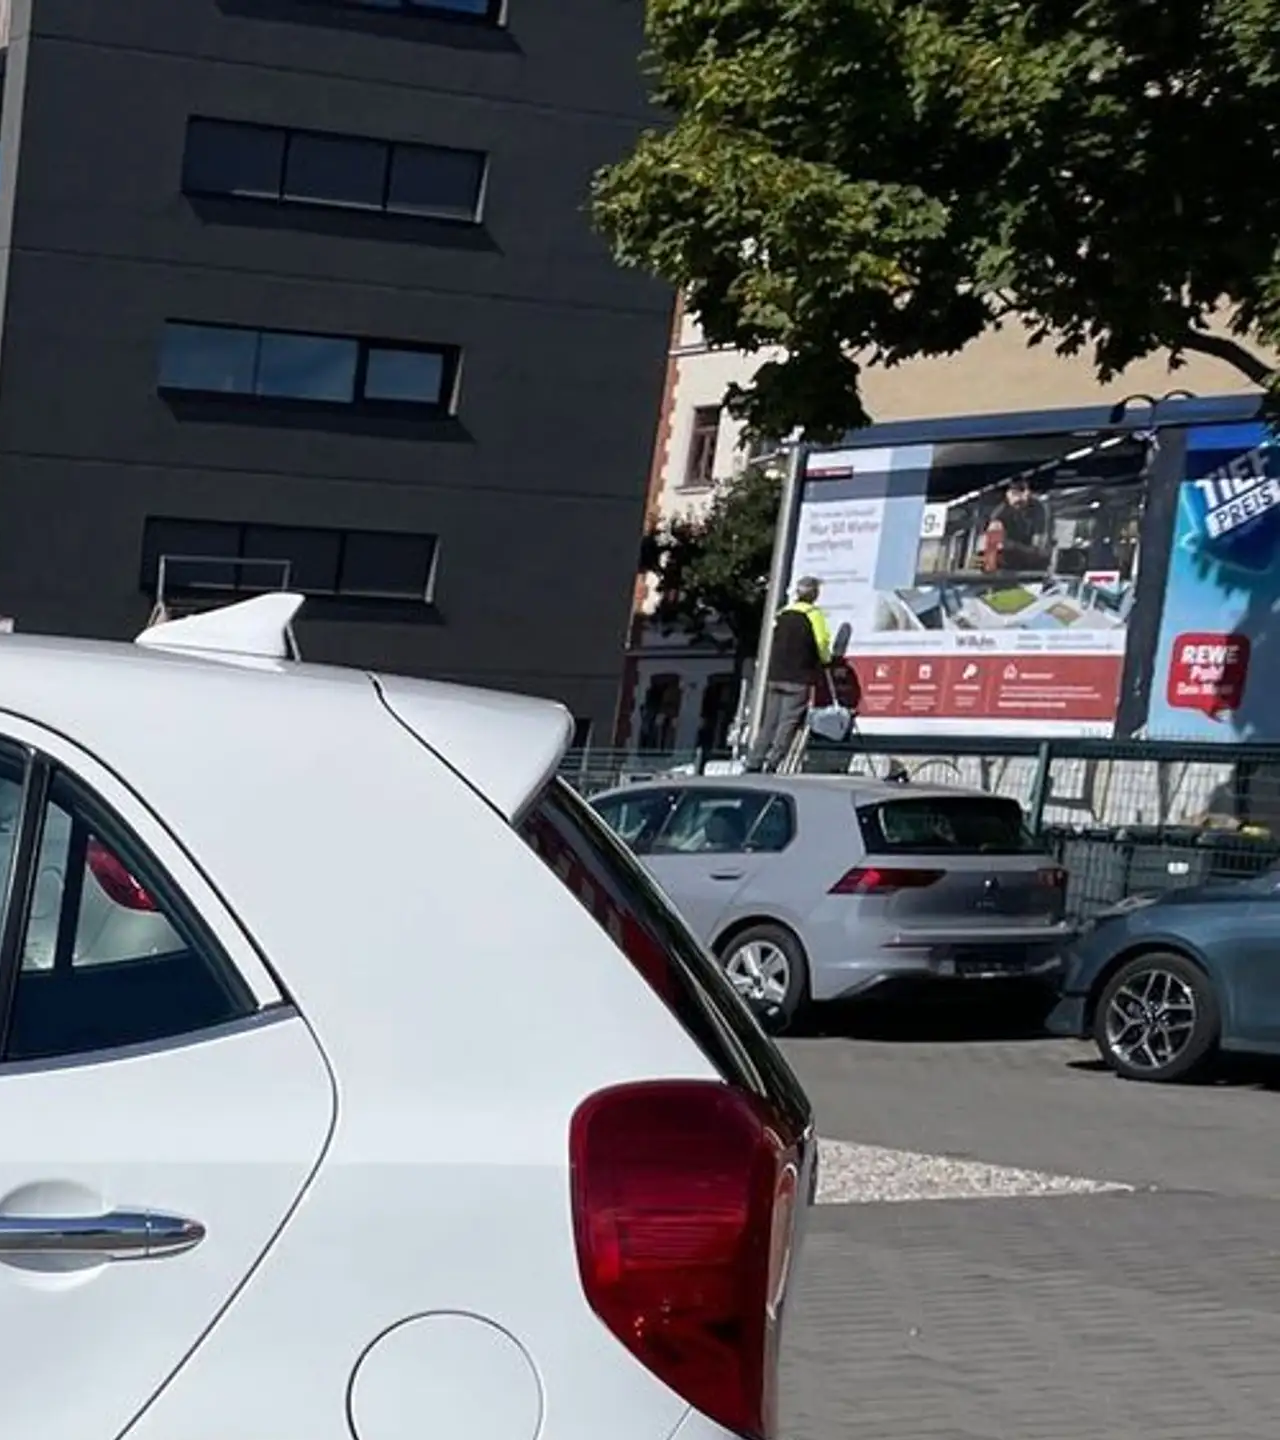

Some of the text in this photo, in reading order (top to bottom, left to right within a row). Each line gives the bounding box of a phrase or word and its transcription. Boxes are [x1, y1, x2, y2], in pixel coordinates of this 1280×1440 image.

[1194, 446, 1271, 510] TIEF
[1216, 484, 1273, 531] PREIS
[1181, 644, 1240, 665] REWE
